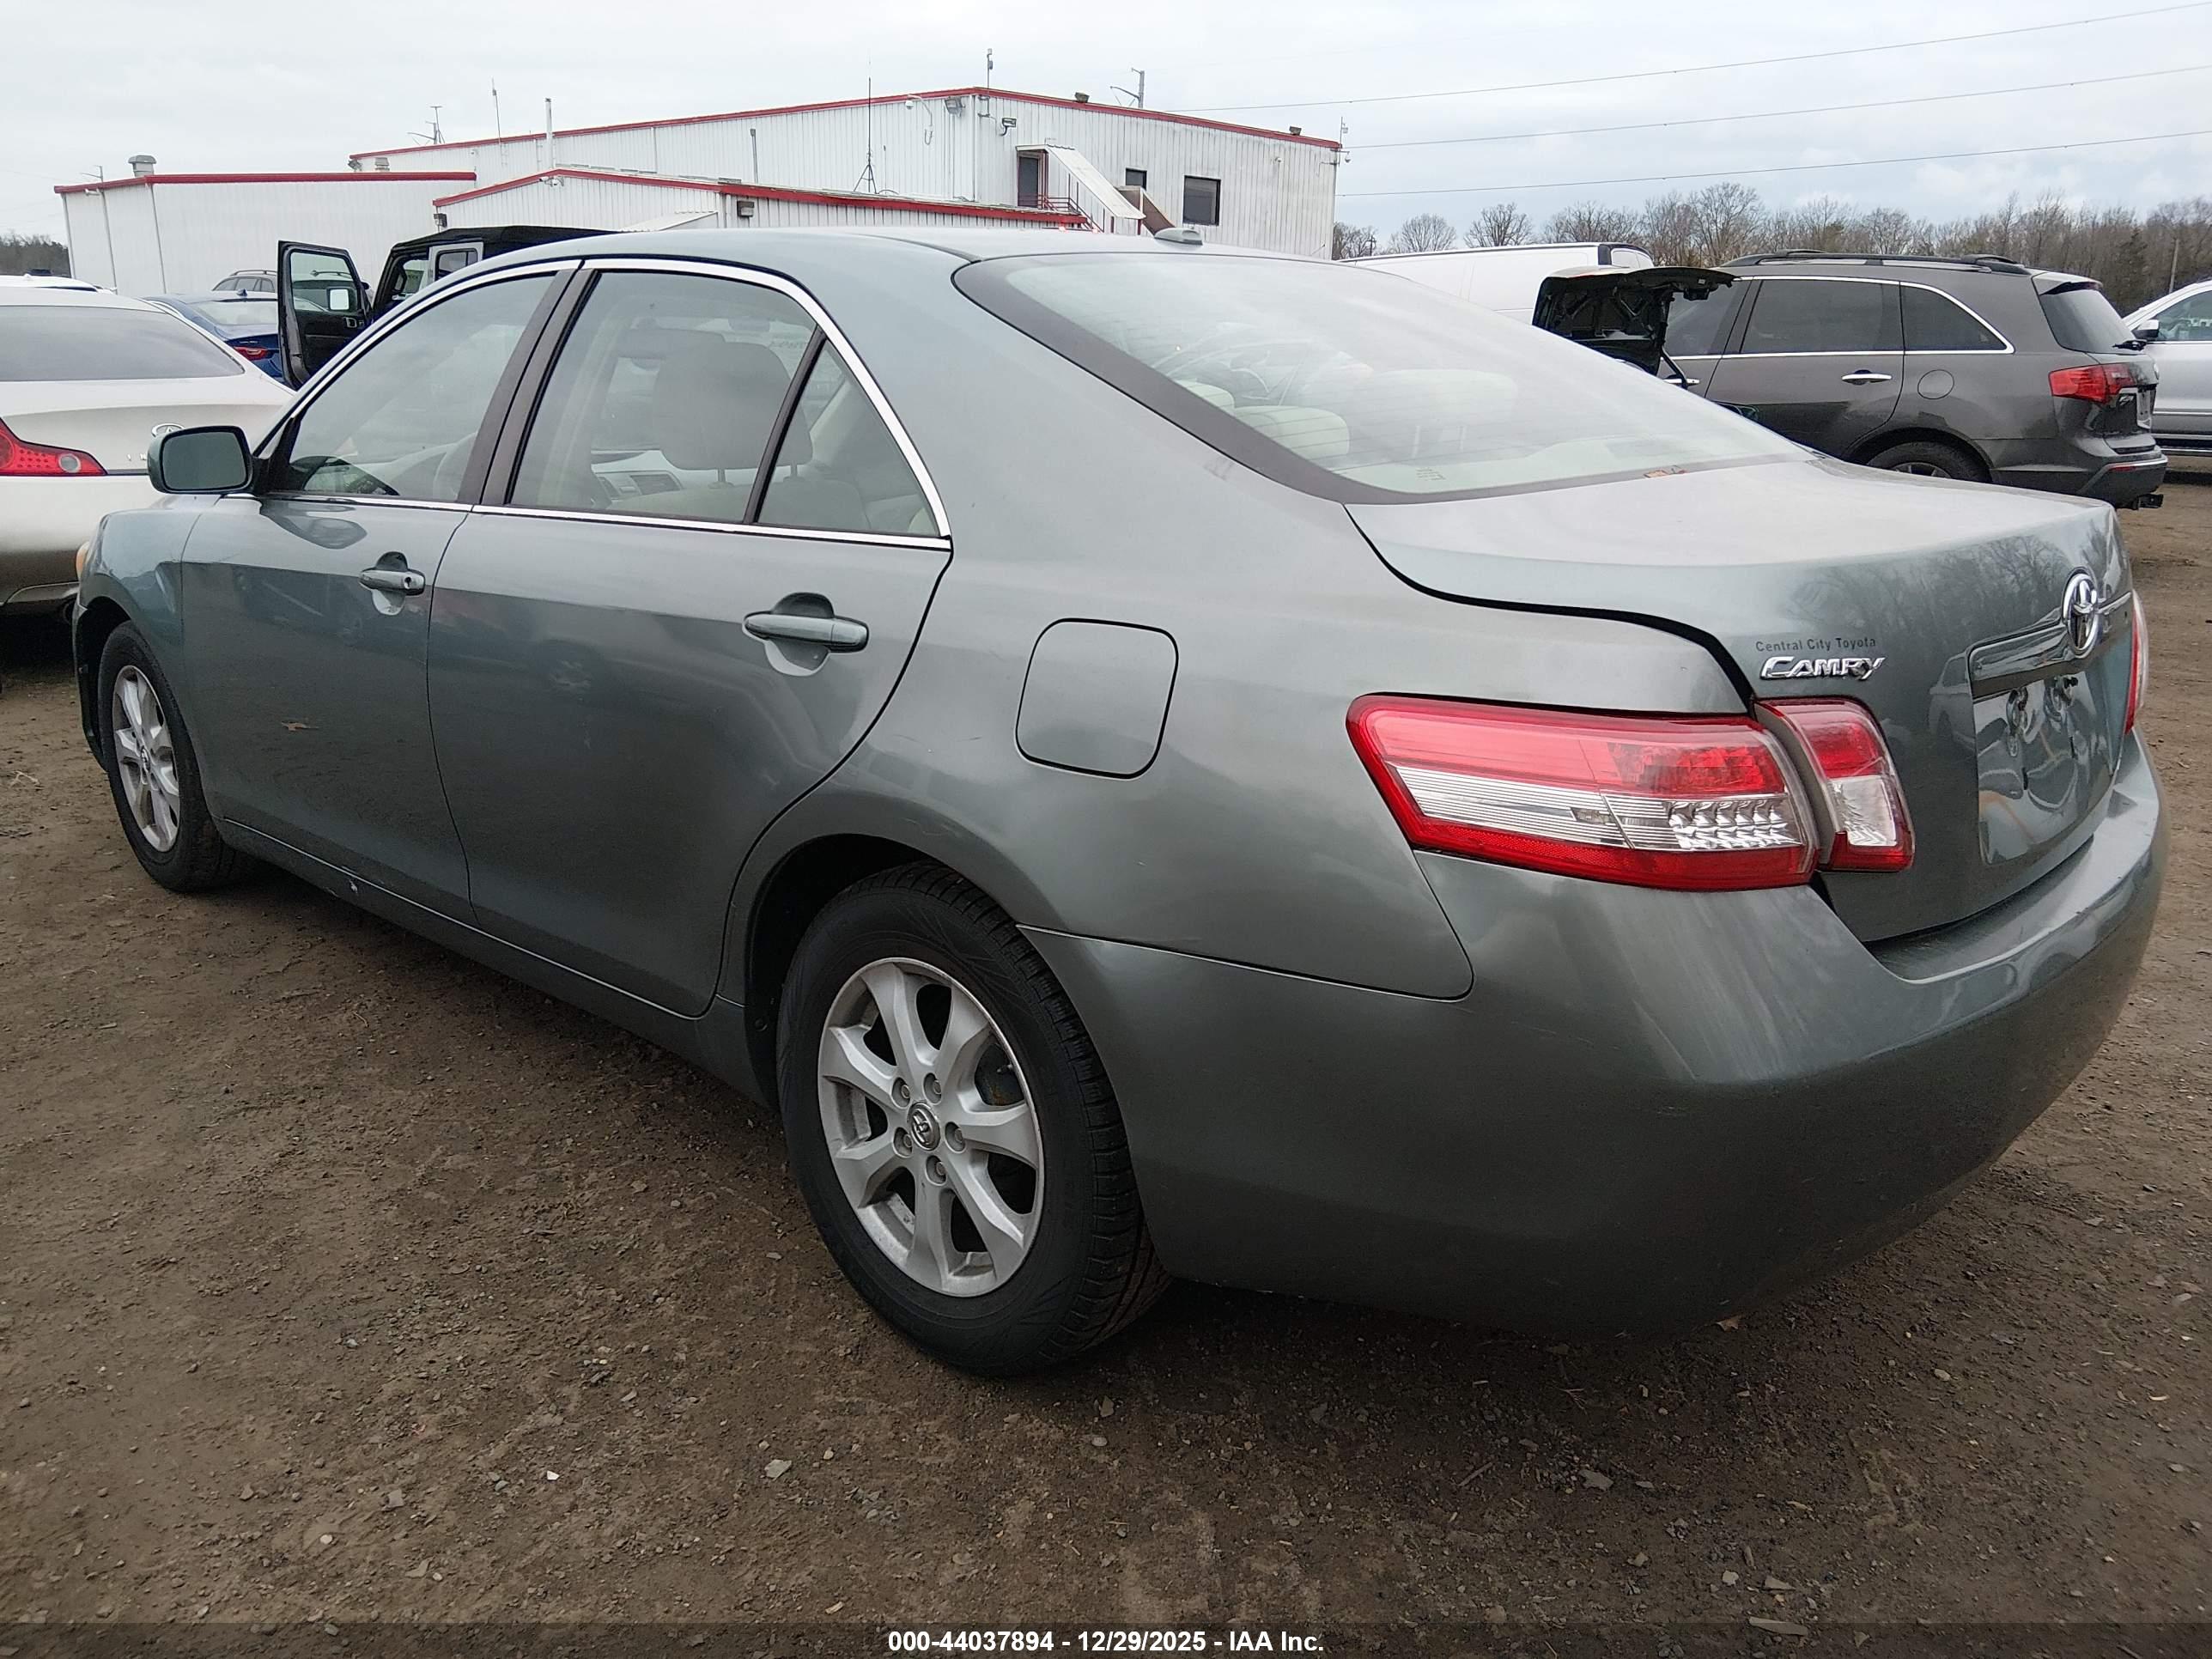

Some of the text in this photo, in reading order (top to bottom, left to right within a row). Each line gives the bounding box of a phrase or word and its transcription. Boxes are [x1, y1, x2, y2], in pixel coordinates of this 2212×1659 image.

[1755, 637, 1876, 653] Central City Toyota
